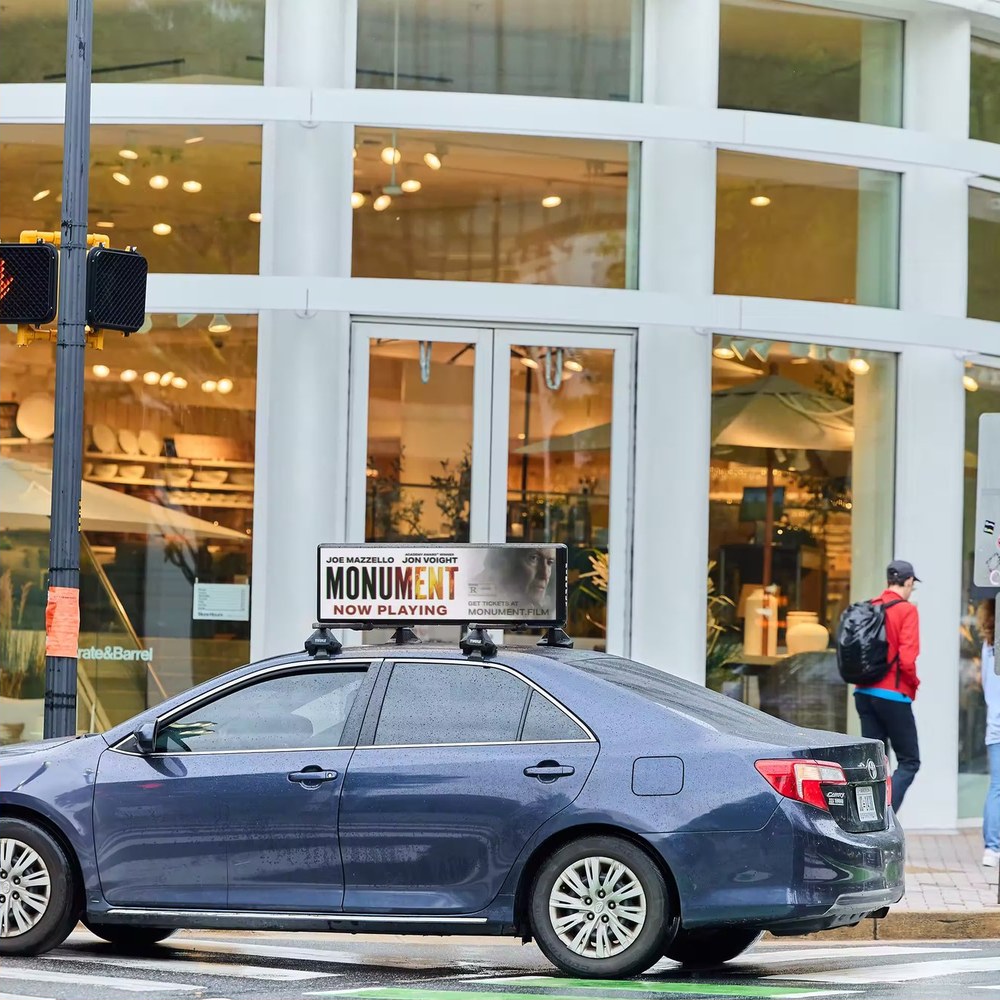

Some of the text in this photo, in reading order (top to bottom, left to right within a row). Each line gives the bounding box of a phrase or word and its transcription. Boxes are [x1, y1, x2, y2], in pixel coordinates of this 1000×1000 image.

[326, 566, 458, 600] MONUMENT
[333, 605, 447, 616] NOW PLAYING
[468, 608, 549, 616] MONUMENT.FILM
[78, 646, 153, 661] rate&Barrel
